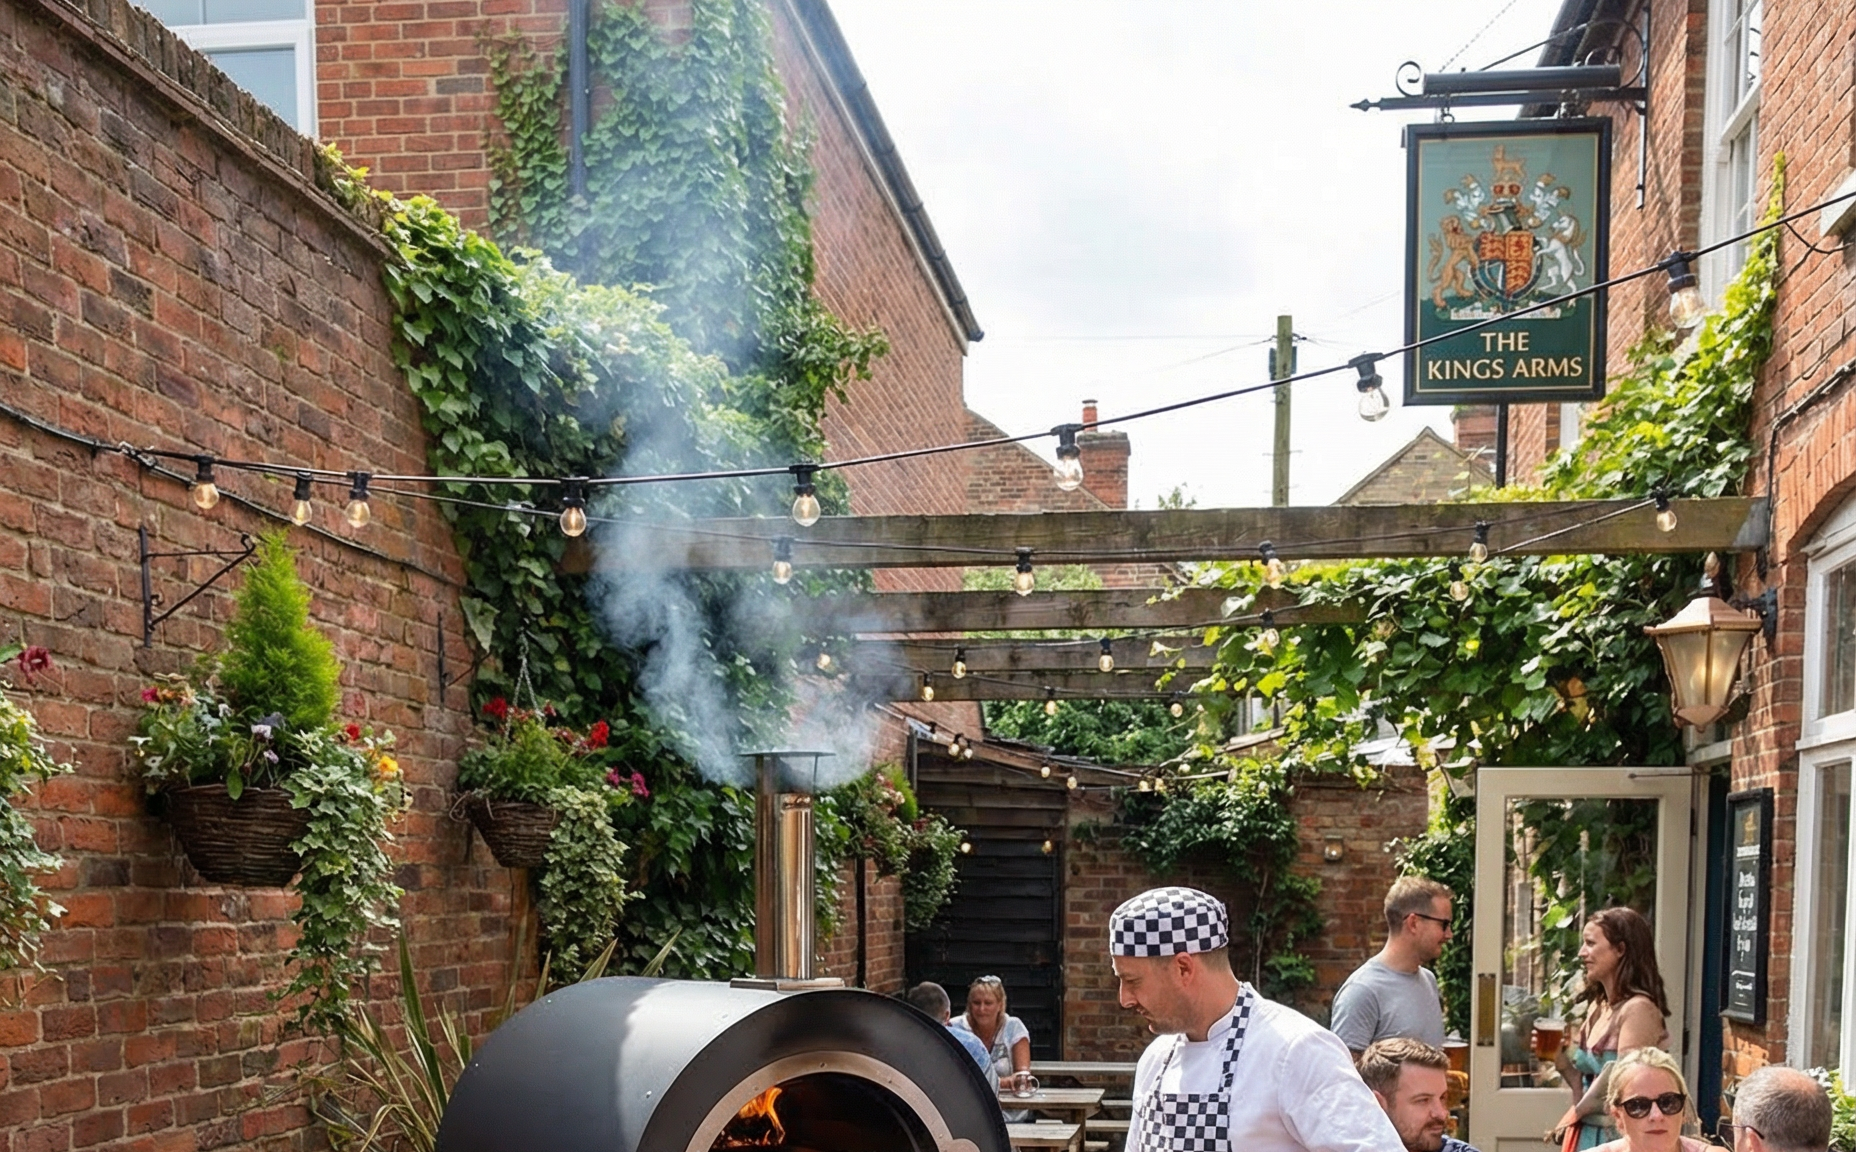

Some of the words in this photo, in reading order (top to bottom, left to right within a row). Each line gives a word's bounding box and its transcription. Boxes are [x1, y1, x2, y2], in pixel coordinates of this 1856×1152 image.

[1480, 332, 1530, 352] THE
[1427, 358, 1505, 380] KINGS
[1512, 357, 1583, 378] ARMS
